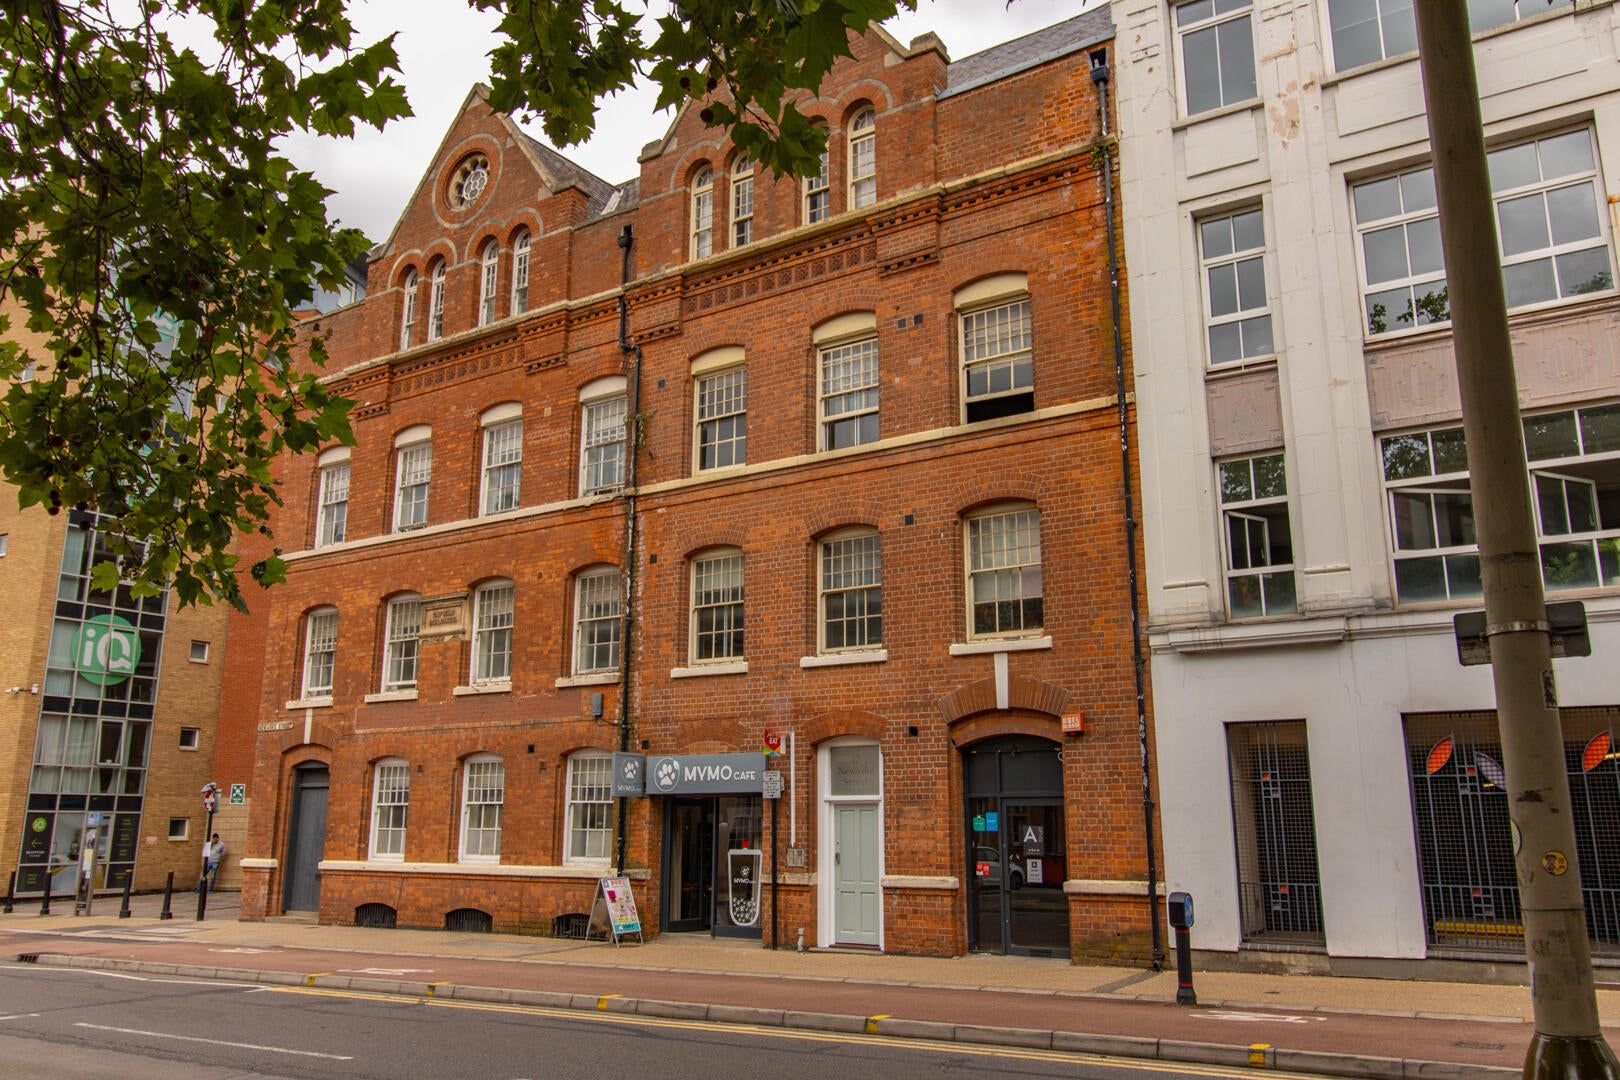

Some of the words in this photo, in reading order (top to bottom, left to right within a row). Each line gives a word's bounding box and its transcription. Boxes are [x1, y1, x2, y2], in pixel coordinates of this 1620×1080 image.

[83, 628, 132, 670] iQ
[769, 737, 779, 745] EAT
[684, 765, 732, 781] MYMO
[733, 771, 756, 781] CAFE
[617, 784, 635, 792] MYMO
